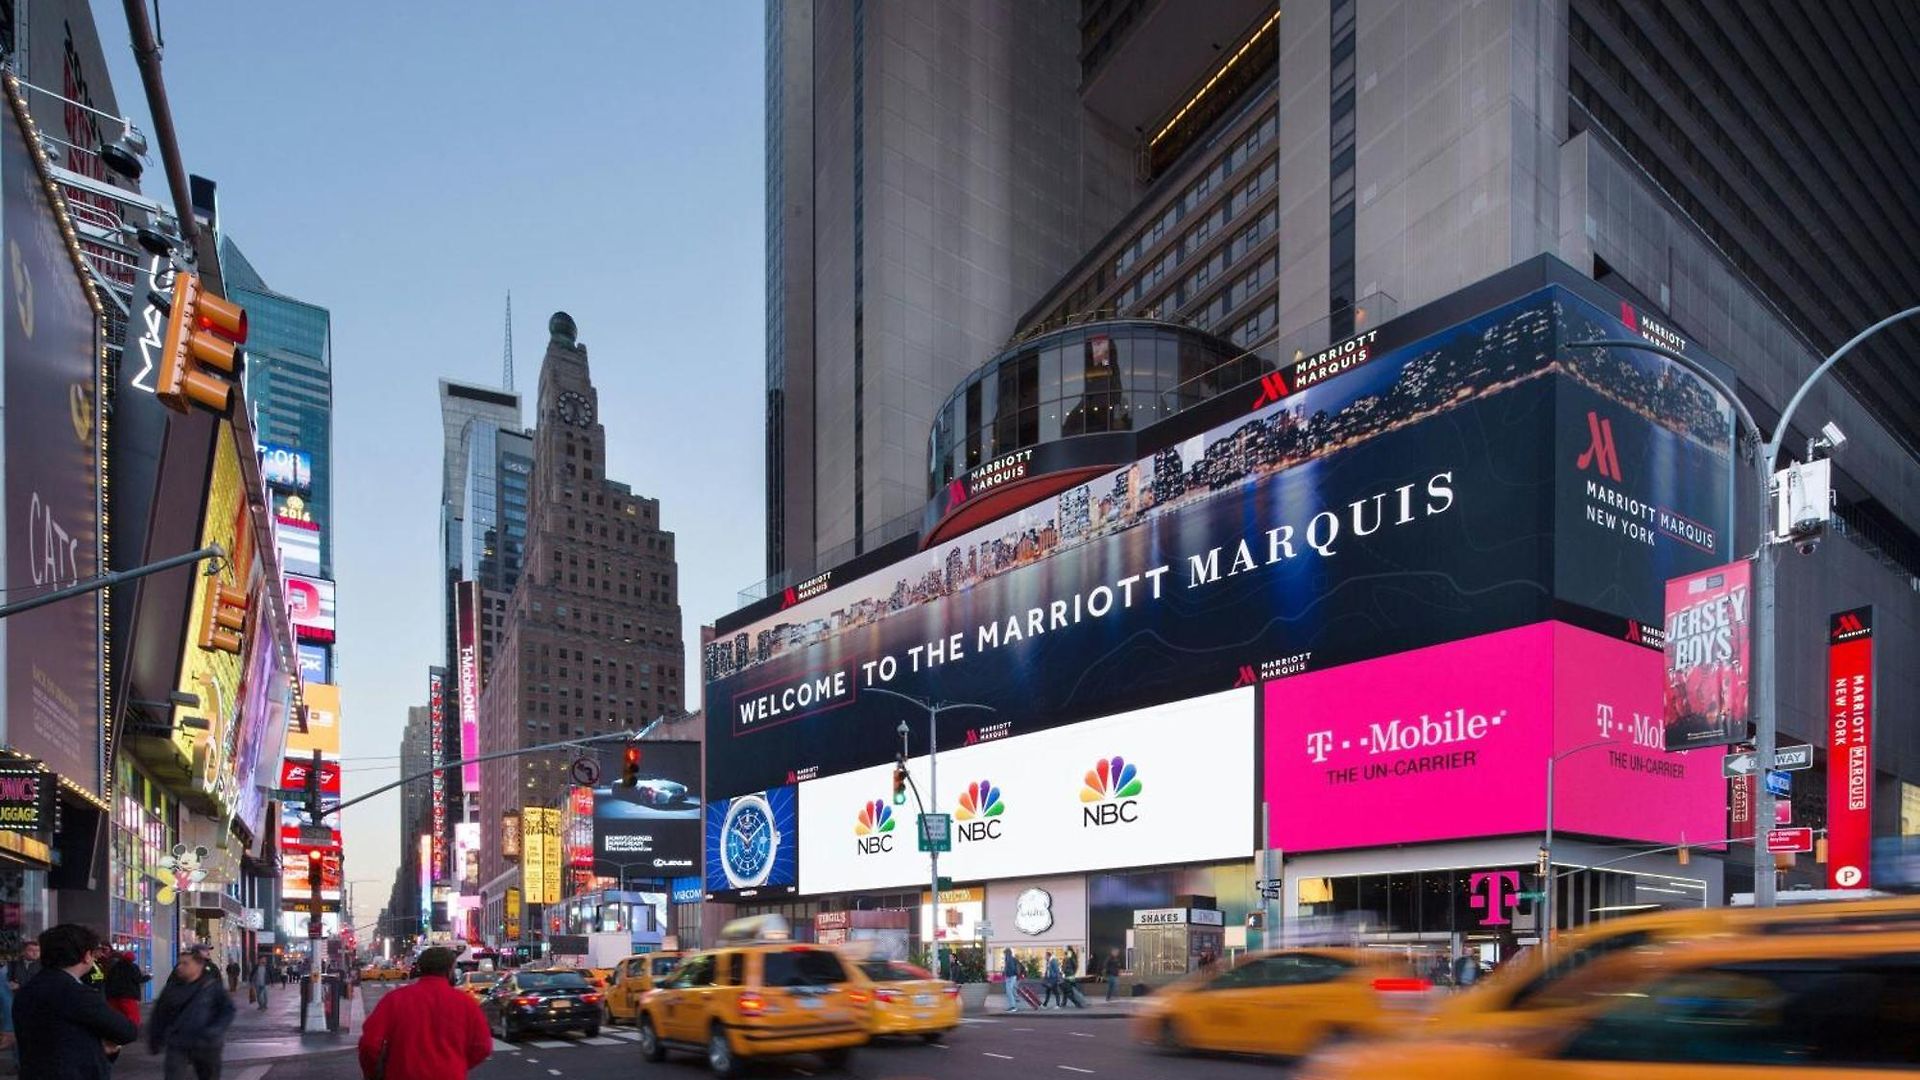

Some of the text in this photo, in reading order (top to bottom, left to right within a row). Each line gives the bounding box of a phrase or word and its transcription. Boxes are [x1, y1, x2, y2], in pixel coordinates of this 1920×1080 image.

[1642, 315, 1686, 351] MARRIOTT
[1296, 330, 1377, 374] MARRIOTT
[1296, 350, 1368, 388] MARQUIS
[970, 450, 1033, 482] MARRIOTT
[970, 464, 1025, 495] MARQUIS
[280, 506, 311, 522] 2016
[1587, 480, 1714, 549] MARRIOTT MARQUIS
[1587, 505, 1655, 546] NEW YORK
[29, 492, 78, 592] CATS
[798, 571, 832, 590] MARRIOTT
[798, 582, 829, 600] MARQUIS
[740, 471, 1454, 725] WELCOME TO THE MARRIOTT MARQUIS
[1667, 588, 1747, 643] JERSEY
[1642, 625, 1665, 638] MARRIO
[1838, 628, 1871, 639] MARRIOTT
[1261, 652, 1312, 670] MARRIOTT
[1675, 626, 1733, 670] BOYS
[1261, 662, 1306, 679] MARQUIS
[1835, 678, 1847, 746] NEW YORK
[980, 721, 1011, 734] MARRIOTT
[980, 729, 1008, 741] MARQUIS
[1851, 675, 1864, 808] MARRIOTT MARQUIS
[1327, 751, 1477, 786] THE UN-CARRIER
[1609, 751, 1684, 778] THE UN-CARRIER
[1776, 753, 1802, 763] WAY
[1083, 800, 1138, 828] NBC
[858, 834, 893, 855] NBC
[958, 819, 1002, 843] NBC
[1844, 870, 1855, 882] P
[1141, 913, 1179, 923] SHAKES
